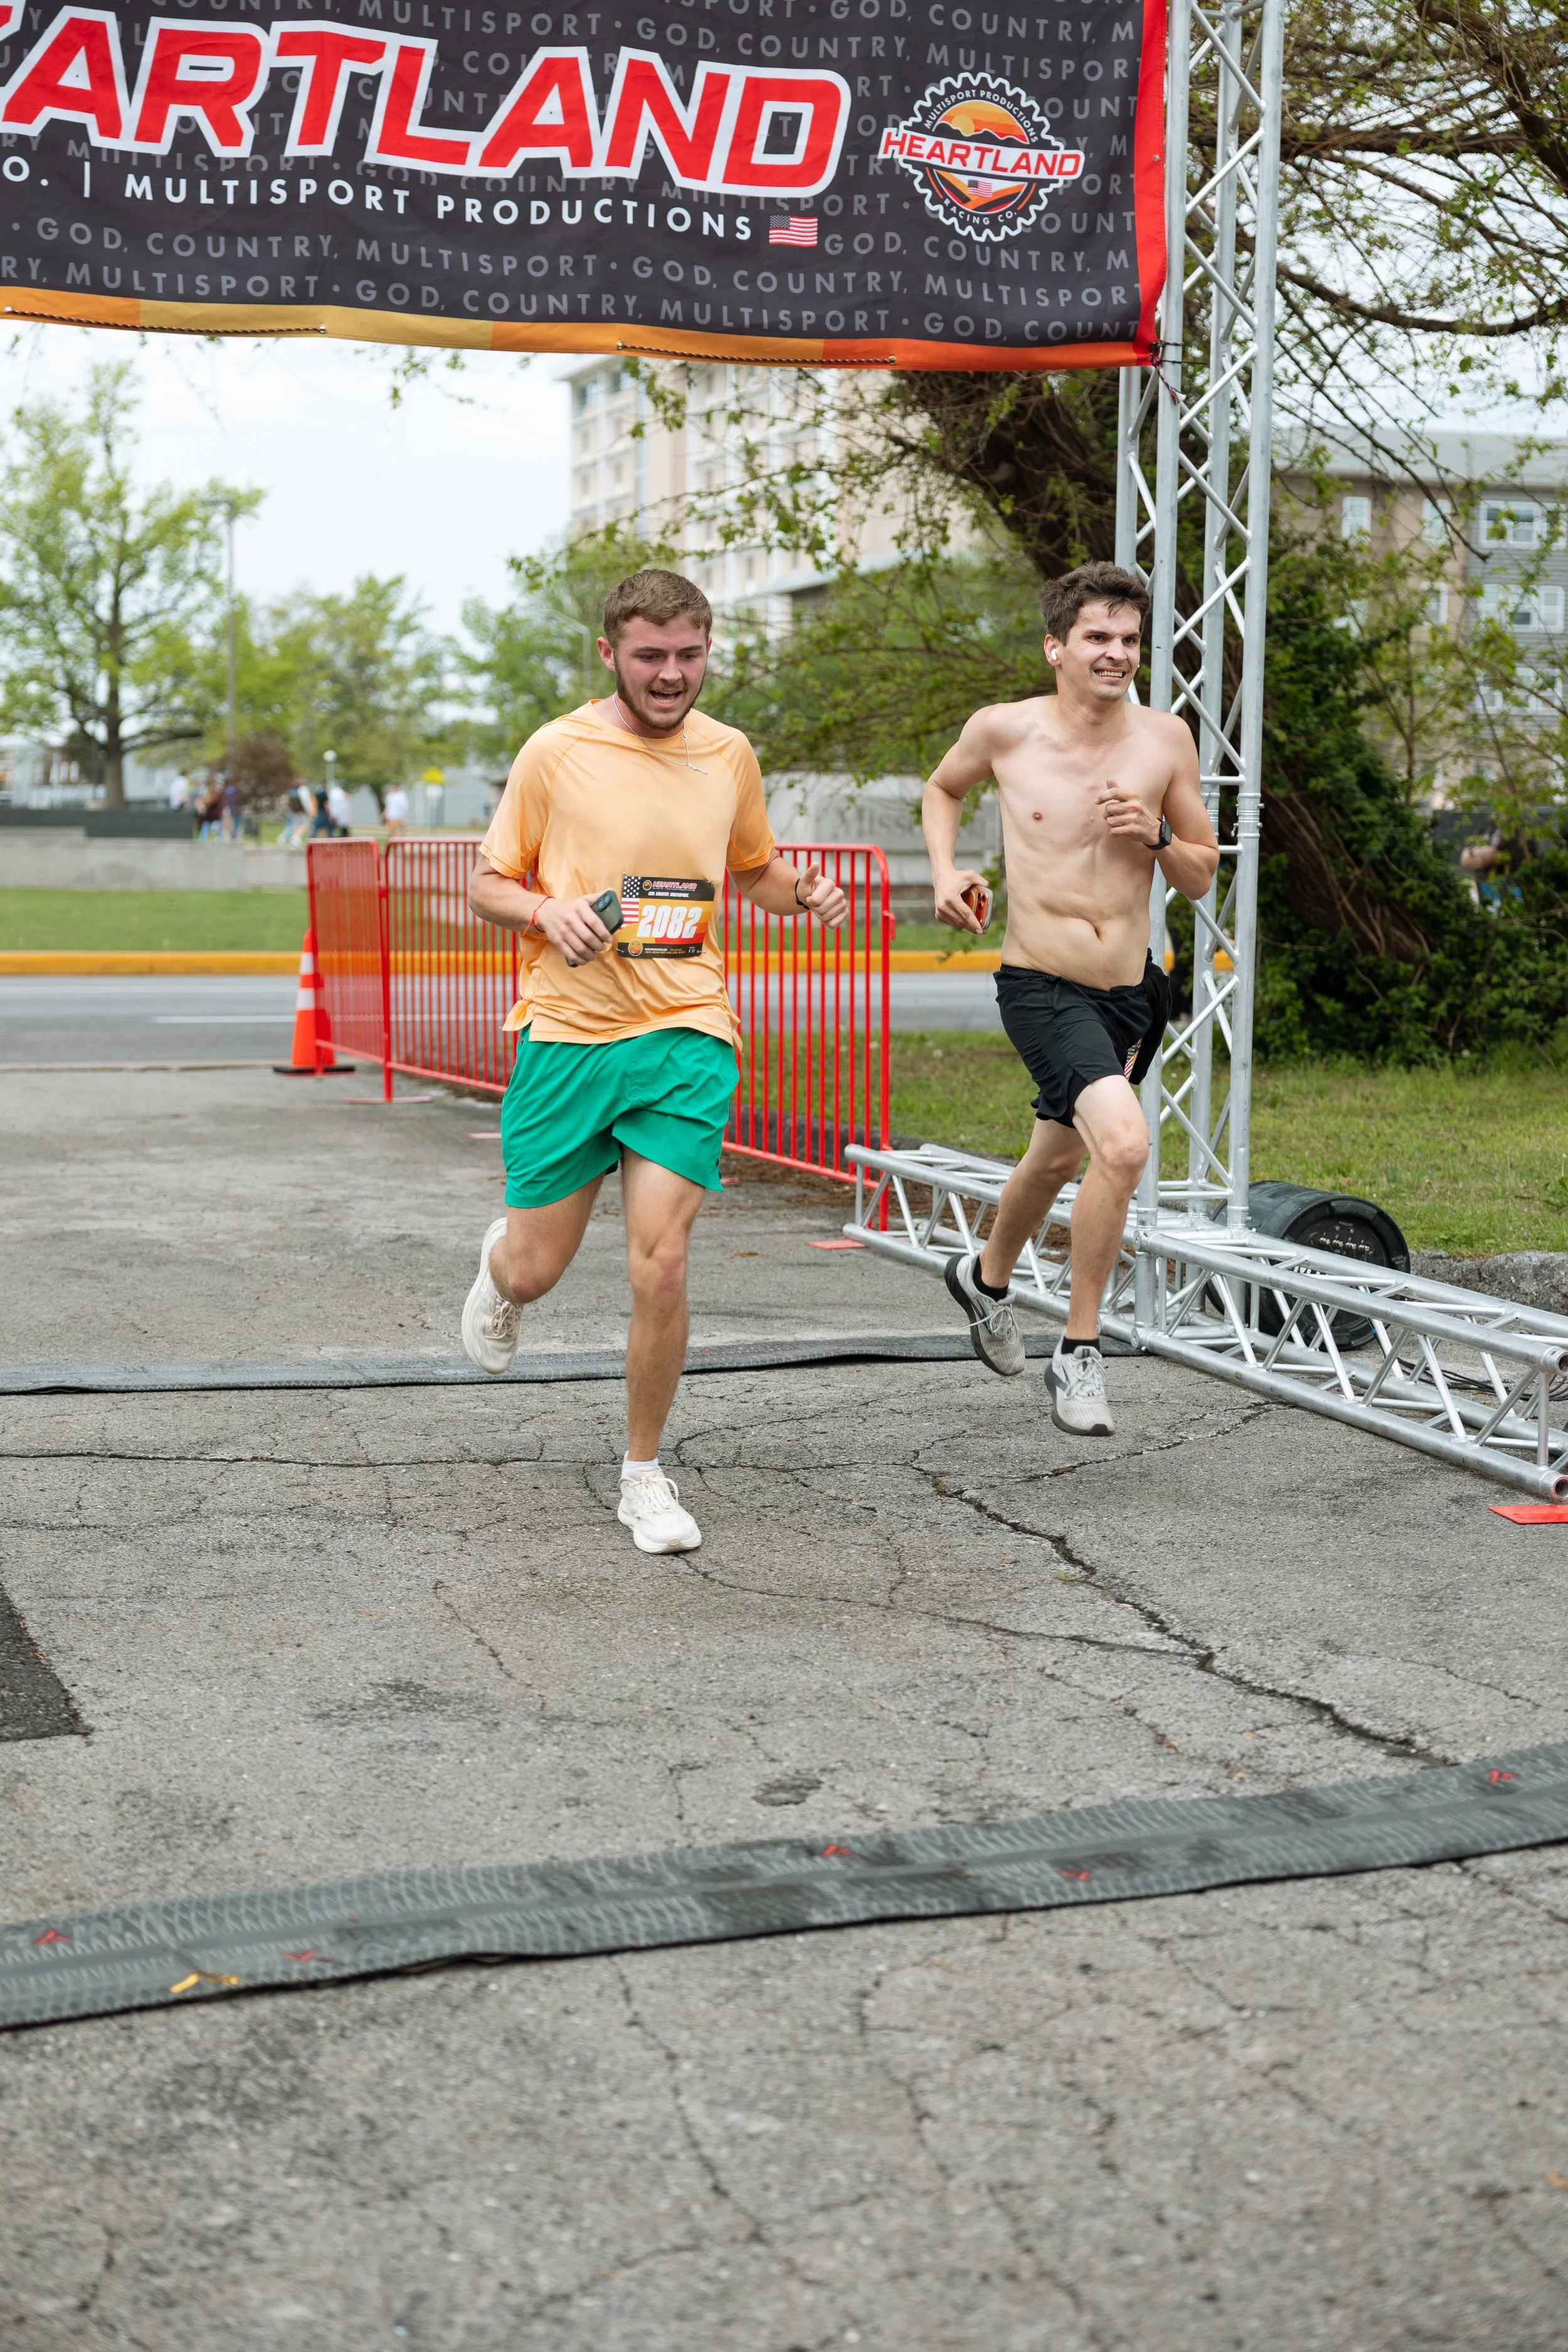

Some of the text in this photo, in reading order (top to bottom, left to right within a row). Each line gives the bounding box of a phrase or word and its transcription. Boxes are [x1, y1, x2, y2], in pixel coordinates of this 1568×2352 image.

[358, 0, 601, 35] MULTISPORT
[637, 18, 721, 53] GOD,
[737, 33, 911, 61] COUNTRY,
[929, 4, 1096, 43] COUNTRY,
[0, 5, 852, 198] ARTLAND
[923, 89, 1039, 143] MULTISPORT PRODUCTIONS
[878, 127, 1086, 181] HEARTLAND
[125, 173, 410, 214] MULTISPORT
[437, 194, 751, 241] PRODUCTIONS
[943, 198, 991, 225] RACING
[36, 216, 128, 253] GOD,
[146, 233, 339, 259] COUNTRY,
[356, 239, 597, 277] MULTISPORT
[632, 257, 718, 290] GOD,
[733, 270, 908, 294] COUNTRY,
[824, 231, 908, 255] GOD,
[924, 236, 1091, 273] COUNTRY,
[66, 262, 319, 297] MULTISPORT
[356, 279, 445, 312] GOD,
[463, 290, 643, 319] COUNTRY,
[660, 300, 889, 332] MULTISPORT
[924, 313, 1007, 342] GOD,
[652, 881, 697, 890] HEARTLAND
[637, 904, 703, 939] 2082
